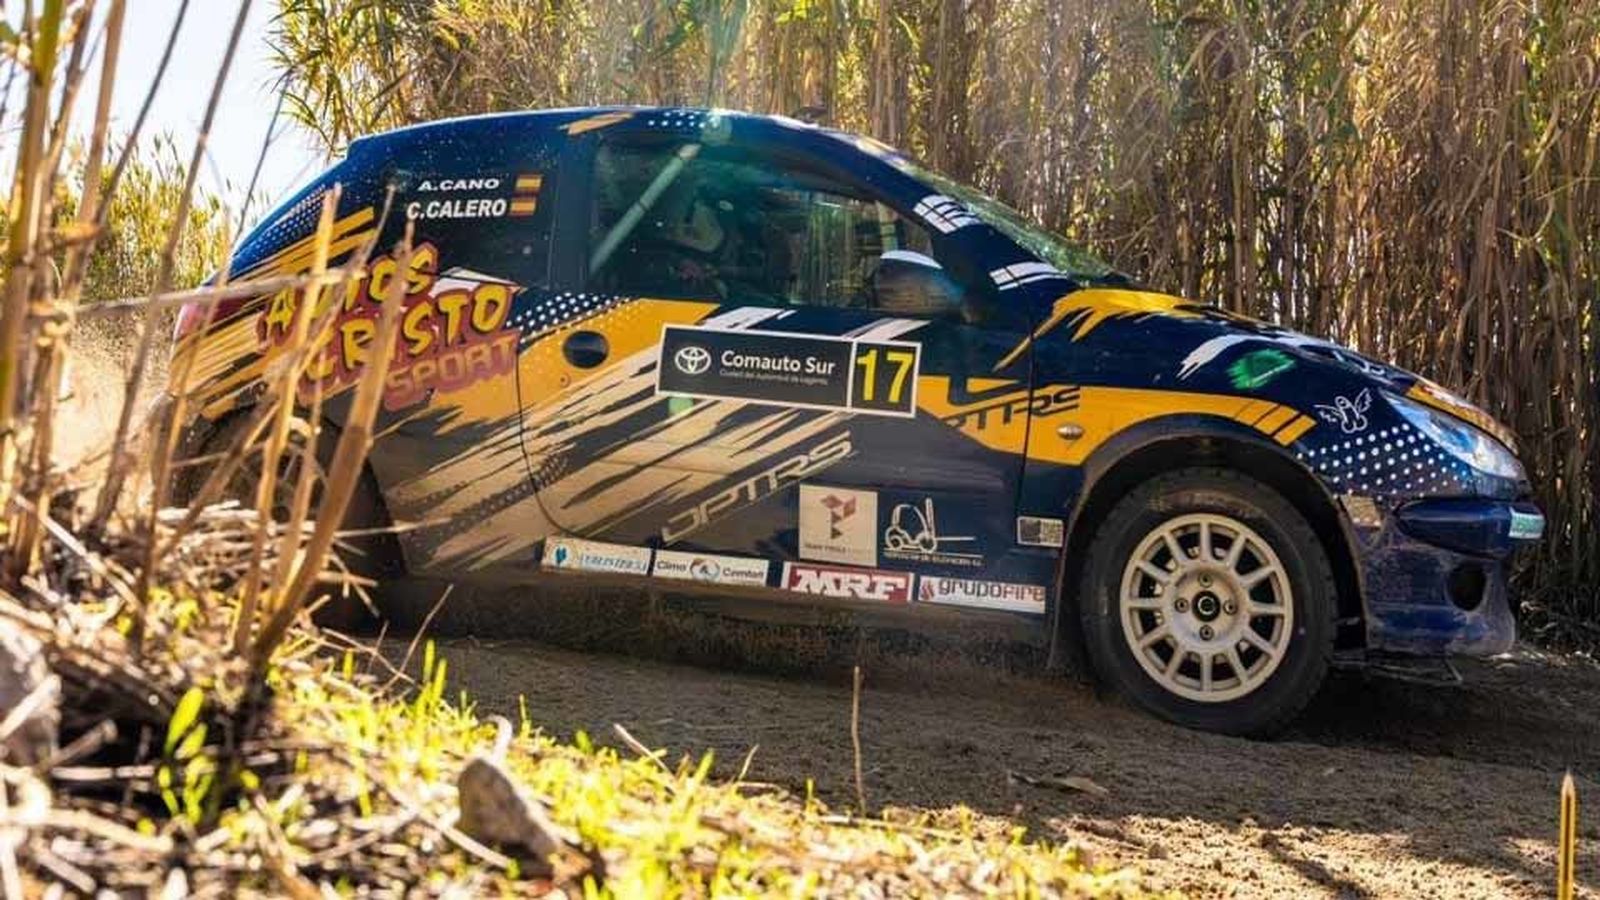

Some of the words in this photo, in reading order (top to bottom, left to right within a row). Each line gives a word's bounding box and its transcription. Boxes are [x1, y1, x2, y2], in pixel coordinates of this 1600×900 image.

[417, 178, 500, 191] A.CANO
[406, 199, 507, 219] C.CALERO
[307, 283, 508, 380] CRSTO
[385, 341, 518, 393] SPORT
[721, 350, 801, 372] Comauto
[805, 356, 836, 375] Sur
[857, 349, 914, 403] 17
[791, 568, 906, 600] MRF
